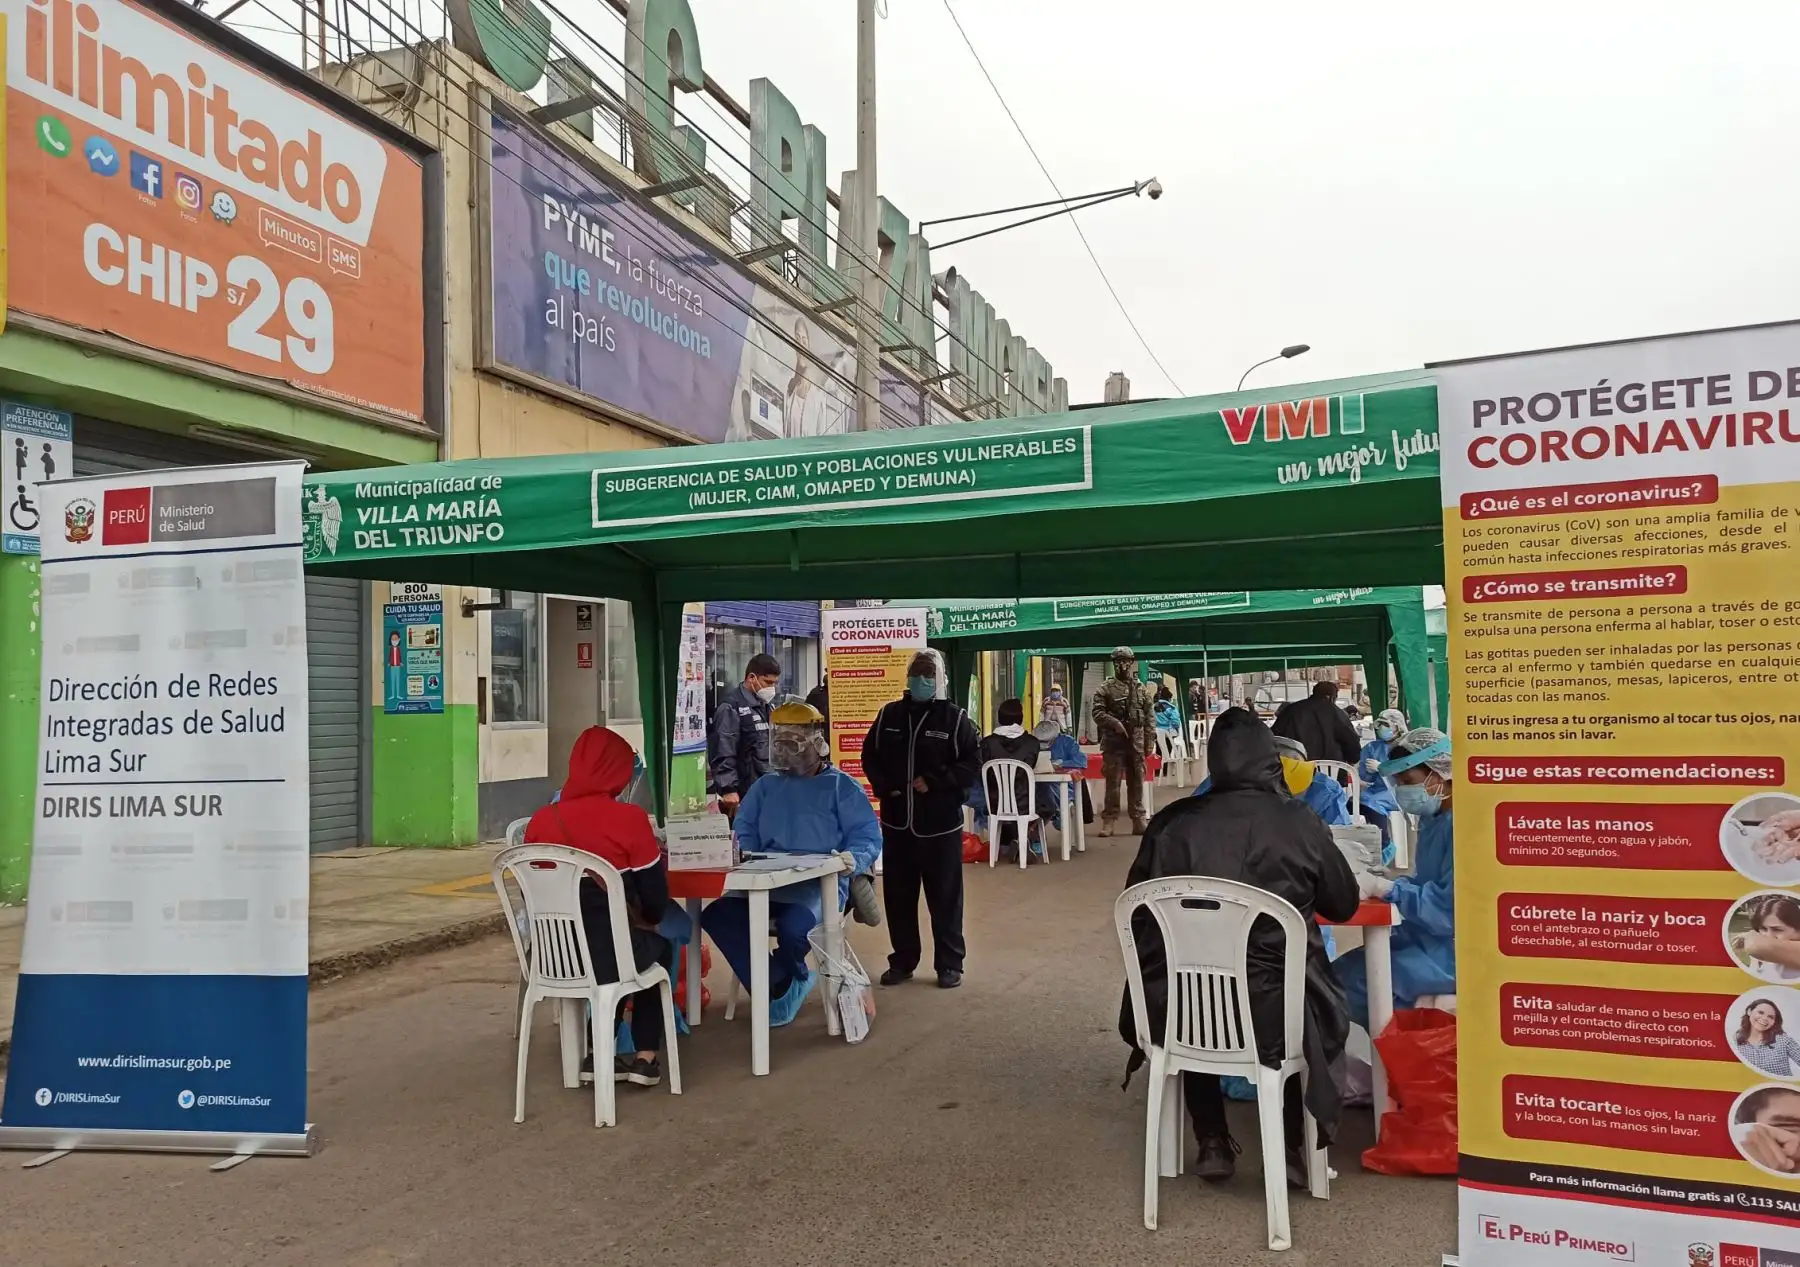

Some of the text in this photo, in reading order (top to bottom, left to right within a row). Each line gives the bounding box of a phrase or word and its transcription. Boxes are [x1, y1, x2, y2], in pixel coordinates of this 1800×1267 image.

[26, 0, 362, 224] ilimitado
[264, 216, 317, 252] Minutos
[332, 247, 357, 270] SMS
[543, 194, 704, 317] PYME, la fuerza
[83, 222, 219, 313] CHIP
[226, 255, 333, 374] 29
[545, 248, 712, 360] que revoluciona
[546, 296, 617, 352] al país
[1473, 374, 1733, 428] PROTÉGETE
[7, 414, 68, 432] PREFERENCIAL
[15, 408, 59, 422] ATENCIÓN
[1468, 409, 1800, 469] CORONAVIRU
[605, 437, 1076, 494] SUBGERENCIA DE SALUD Y POBLACIONES VULNERABLES
[1278, 461, 1311, 484] un
[1318, 442, 1386, 484] mejor
[355, 475, 502, 499] Municipalidad de
[688, 469, 976, 510] (MUJER, CIAM, OMAPED Y DEMUNA)
[160, 505, 214, 516] Ministerio
[357, 494, 502, 525] VILLA MARÍA
[1470, 483, 1702, 516] ¿Qué es el coronavirus?
[110, 505, 145, 524] PERÚ
[160, 519, 205, 532] de Salud
[354, 522, 504, 549] DEL TRIUNFO
[392, 593, 440, 602] PERSONAS
[405, 584, 427, 593] 800
[1473, 573, 1675, 599] ¿Cómo se transmite?
[1060, 600, 1106, 608] SUBGERENCIA
[833, 618, 918, 629] PROTÉGETE DEL
[950, 610, 1016, 622] VILLA MARÍA
[950, 620, 1017, 632] DEL TRIUNFO
[832, 629, 919, 640] CORONAVIRUS
[50, 671, 277, 702] Dirección de Redes
[48, 707, 284, 742] Integradas de Salud
[45, 749, 147, 773] Lima Sur
[1475, 763, 1775, 781] Sigue estas recomendaciones:
[43, 795, 222, 818] DIRIS LIMA SUR
[1509, 816, 1653, 832] Lávate las manos
[1509, 833, 1692, 848] frecuentemente, con agua y jabón,
[1509, 845, 1619, 859] mínimo 20 segundos.
[1510, 905, 1706, 927] Cúbrete la nariz y boca
[78, 1056, 231, 1070] www.dirislimasur.gob.pe
[54, 1092, 120, 1104] /DIRISLimaSur
[197, 1095, 271, 1107] @DIRISLimaSur
[1516, 1092, 1716, 1123] Evita tocarte los ojos, la nariz
[1529, 1172, 1553, 1182] Para
[1556, 1175, 1579, 1185] más
[1582, 1177, 1650, 1194] información
[1653, 1186, 1685, 1198] llama
[1688, 1190, 1720, 1203] gratis
[1722, 1193, 1734, 1203] al
[1751, 1197, 1773, 1208] 113
[1485, 1221, 1627, 1255] EL PERÚ PRIMERO
[1725, 1256, 1754, 1267] PERÚ
